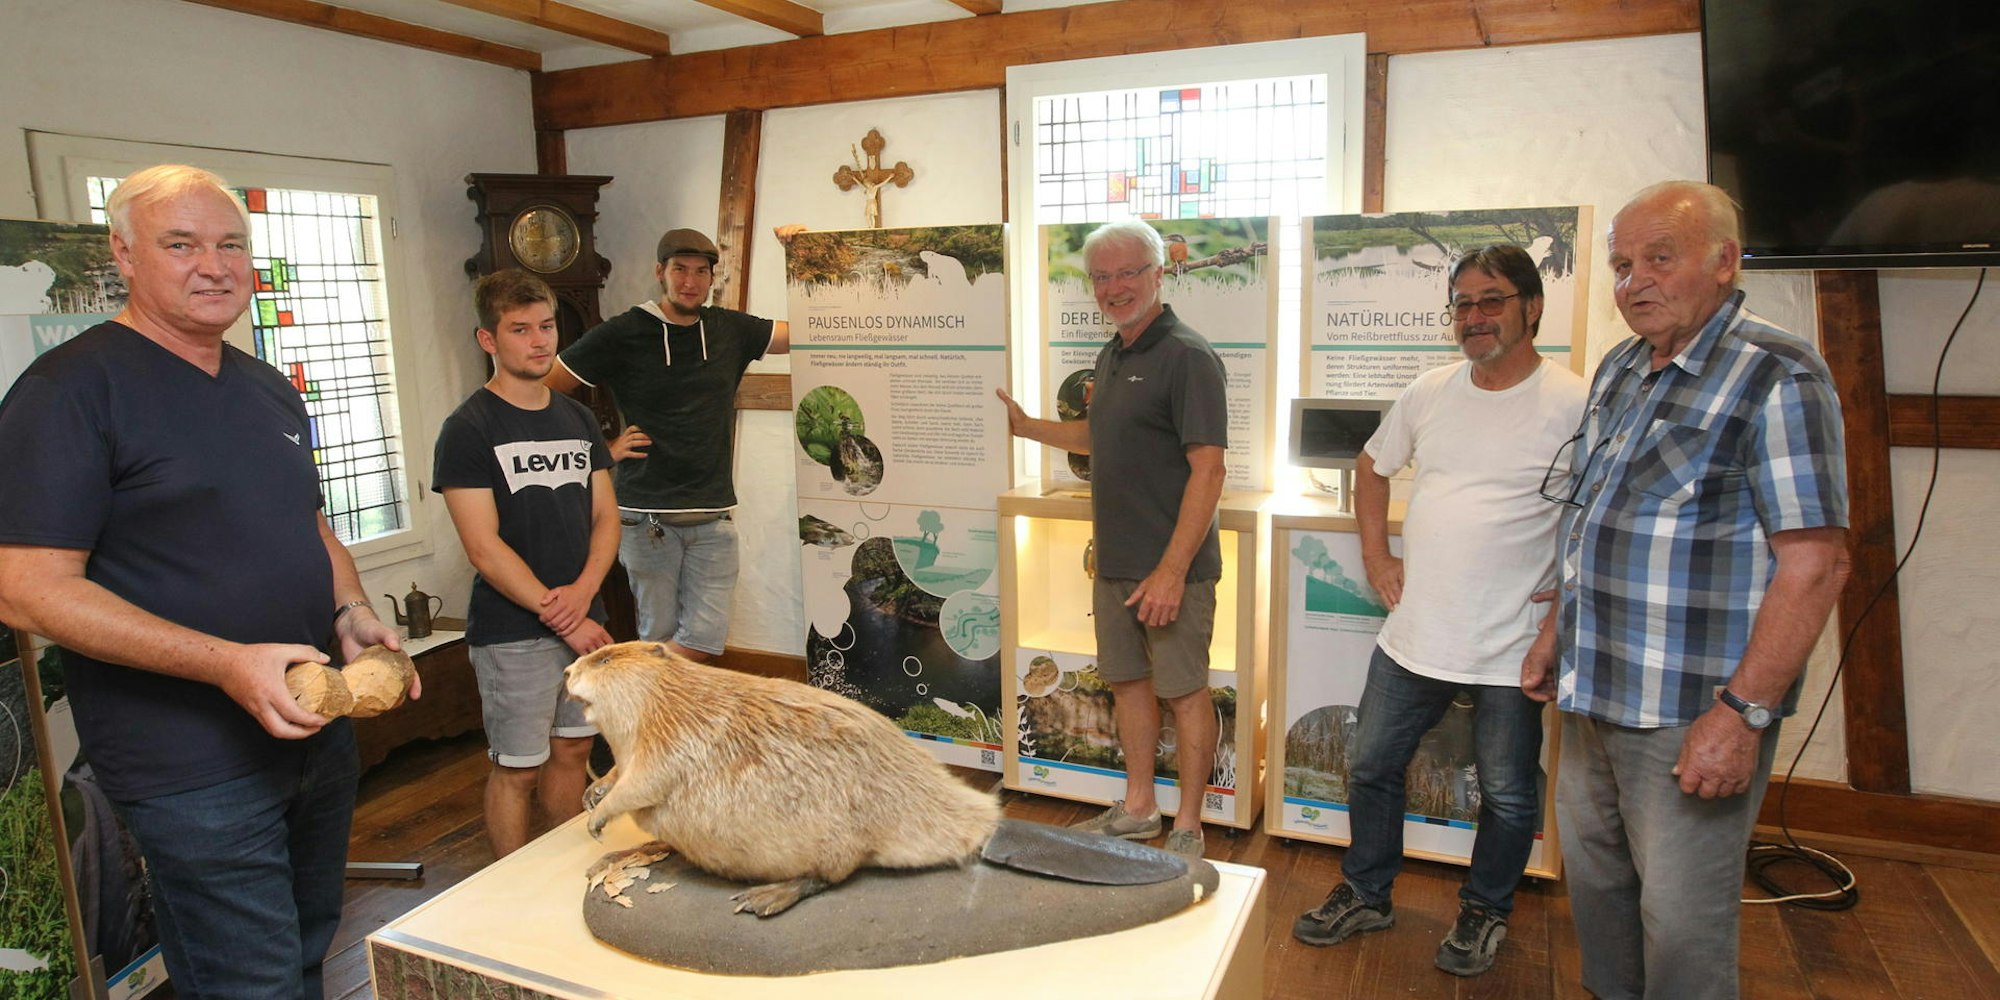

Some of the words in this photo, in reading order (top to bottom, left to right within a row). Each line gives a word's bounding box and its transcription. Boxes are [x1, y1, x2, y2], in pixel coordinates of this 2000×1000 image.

[808, 316, 883, 329] PAUSENLOS
[886, 315, 965, 329] DYNAMISCH
[1061, 312, 1089, 325] DER
[1092, 312, 1113, 325] EI
[1327, 309, 1435, 327] NATÜRLICHE
[1440, 311, 1452, 327] O
[809, 333, 854, 342] Lebensraum
[855, 333, 909, 343] Fließgewässer
[1061, 330, 1074, 339] Ein
[1076, 330, 1114, 340] fliegende
[1327, 332, 1348, 341] Vom
[1351, 331, 1420, 341] Reißbrettfluss
[1441, 332, 1454, 341] Au
[512, 451, 587, 474] Levi's
